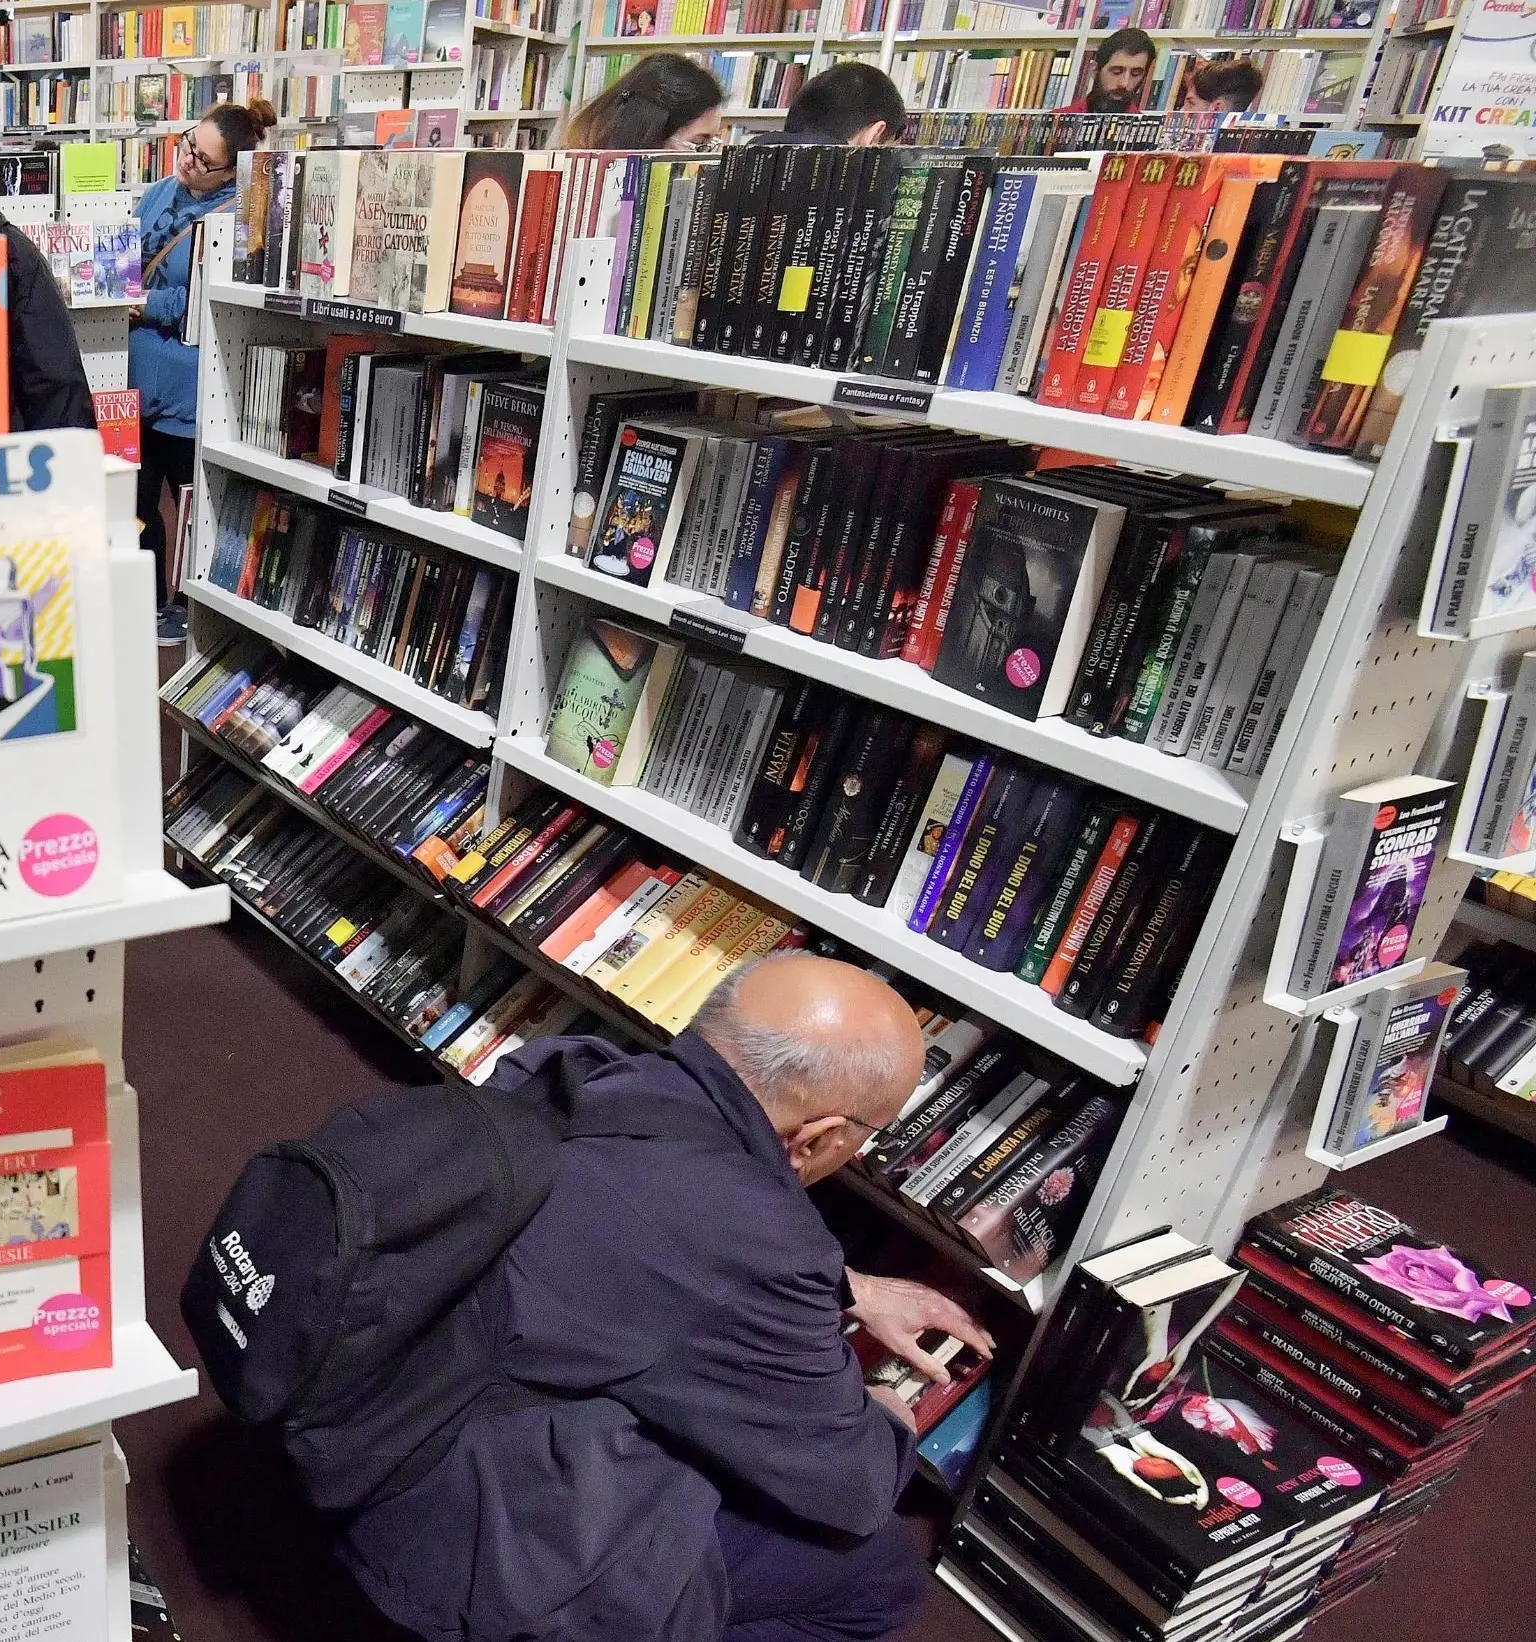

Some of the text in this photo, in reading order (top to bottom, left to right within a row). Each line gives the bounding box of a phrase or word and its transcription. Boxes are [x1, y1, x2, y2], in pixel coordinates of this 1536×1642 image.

[1481, 83, 1500, 93] TUA
[1434, 105, 1471, 122] KIT
[47, 224, 91, 238] STEPHEN
[95, 224, 139, 237] STEPHEN
[468, 214, 499, 228] ASENSI
[988, 179, 1014, 252] DUNNETT
[999, 179, 1023, 253] DOROTHY
[48, 235, 91, 254] KING
[95, 234, 139, 253] KING
[702, 212, 724, 297] VATICANUM
[758, 215, 782, 303] VATICANUM
[728, 217, 750, 303] VATICANUM
[896, 290, 913, 330] Dante
[1062, 261, 1089, 331] CONGIURA
[1065, 261, 1100, 354] MACHIAVELLI
[1129, 270, 1157, 343] CONGIURA
[312, 302, 394, 327] Libri usati a 3 e 5 euro
[905, 288, 926, 339] trappola
[969, 301, 988, 344] BISANZIO
[1132, 270, 1170, 366] MACHIAVELLI
[95, 392, 138, 404] STEPHEN
[95, 402, 139, 422] KING
[485, 392, 539, 417] STEVE BERRY
[841, 387, 888, 401] Fantascienza
[896, 395, 926, 407] Fantasy
[653, 457, 673, 473] DAL
[994, 493, 1071, 524] SUSANA FORTES
[632, 541, 655, 557] Prezzo
[777, 540, 801, 603] L'ADEPTO
[921, 534, 948, 601] SEGRETO DANTE
[1105, 602, 1129, 660] CARAVAGGIO
[1088, 629, 1106, 667] QUADRO
[1010, 660, 1033, 687] speciale
[1014, 649, 1038, 682] Prezzo
[1167, 699, 1193, 745] L'AGGUATO
[1195, 705, 1216, 739] PROPOSTA
[1236, 718, 1259, 754] MISTERO
[594, 743, 615, 759] Prezzo
[720, 794, 735, 825] MAESTRO
[18, 827, 98, 862] Prezzo
[511, 826, 555, 867] scarabeo
[1368, 842, 1434, 872] STARGARD
[1374, 827, 1439, 857] CONRAD
[31, 848, 97, 879] speciale
[946, 836, 992, 920] DONO DEL BUIO
[983, 854, 1032, 940] DONO DEL BUIO
[1063, 865, 1118, 952] VANGELO PROIBITO
[1084, 861, 1141, 963] VANGELO PROIBITO
[664, 897, 714, 940] Sciamano
[1122, 879, 1183, 981] VANGELO PROIBITO
[690, 914, 741, 957] Sciamano
[716, 928, 766, 972] Sciamano
[1382, 932, 1409, 946] Prezzo
[1390, 1012, 1432, 1033] GUERRIERI
[1454, 1002, 1476, 1025] DIMMI
[1467, 996, 1495, 1023] SEGRETO
[931, 1077, 974, 1120] CENTURIONE
[977, 1134, 1021, 1174] CABALISTA
[997, 1176, 1033, 1207] BACIO
[1013, 1206, 1031, 1237] DELLA
[1294, 1199, 1352, 1231] DIARIO
[1034, 1217, 1058, 1251] BACIO
[1290, 1205, 1401, 1262] VAMPIRO
[221, 1230, 260, 1286] Rotary
[223, 1270, 243, 1297] 2042
[1309, 1262, 1407, 1324] DIARIO VAMPIRO
[1487, 1281, 1515, 1299] Prezzo
[33, 1303, 100, 1325] Prezzo
[43, 1317, 100, 1337] speciale
[1301, 1313, 1396, 1376] DIARIO VAMPIRO
[1270, 1333, 1362, 1400] DIARIO DEL VAMPIRO
[1255, 1372, 1345, 1437] DIARIO VAMPIRO
[1317, 1462, 1354, 1475] Prezzo
[1219, 1480, 1249, 1497] Prezzo
[1275, 1477, 1301, 1494] new
[1293, 1485, 1327, 1504] STEPHENIE
[0, 1511, 82, 1545] PENSIER
[1198, 1503, 1243, 1529] twilight
[1207, 1512, 1262, 1543] STEPHENIE MEYER
[0, 1537, 51, 1558] d'amore
[12, 1588, 24, 1598] di
[27, 1580, 52, 1595] dieci
[16, 1566, 61, 1586] d'amore
[3, 1600, 20, 1612] del
[22, 1590, 57, 1606] Medio
[59, 1583, 82, 1596] Evo
[12, 1604, 45, 1621] d'oggi
[20, 1611, 62, 1629] cantano
[24, 1617, 73, 1639] del cuore
